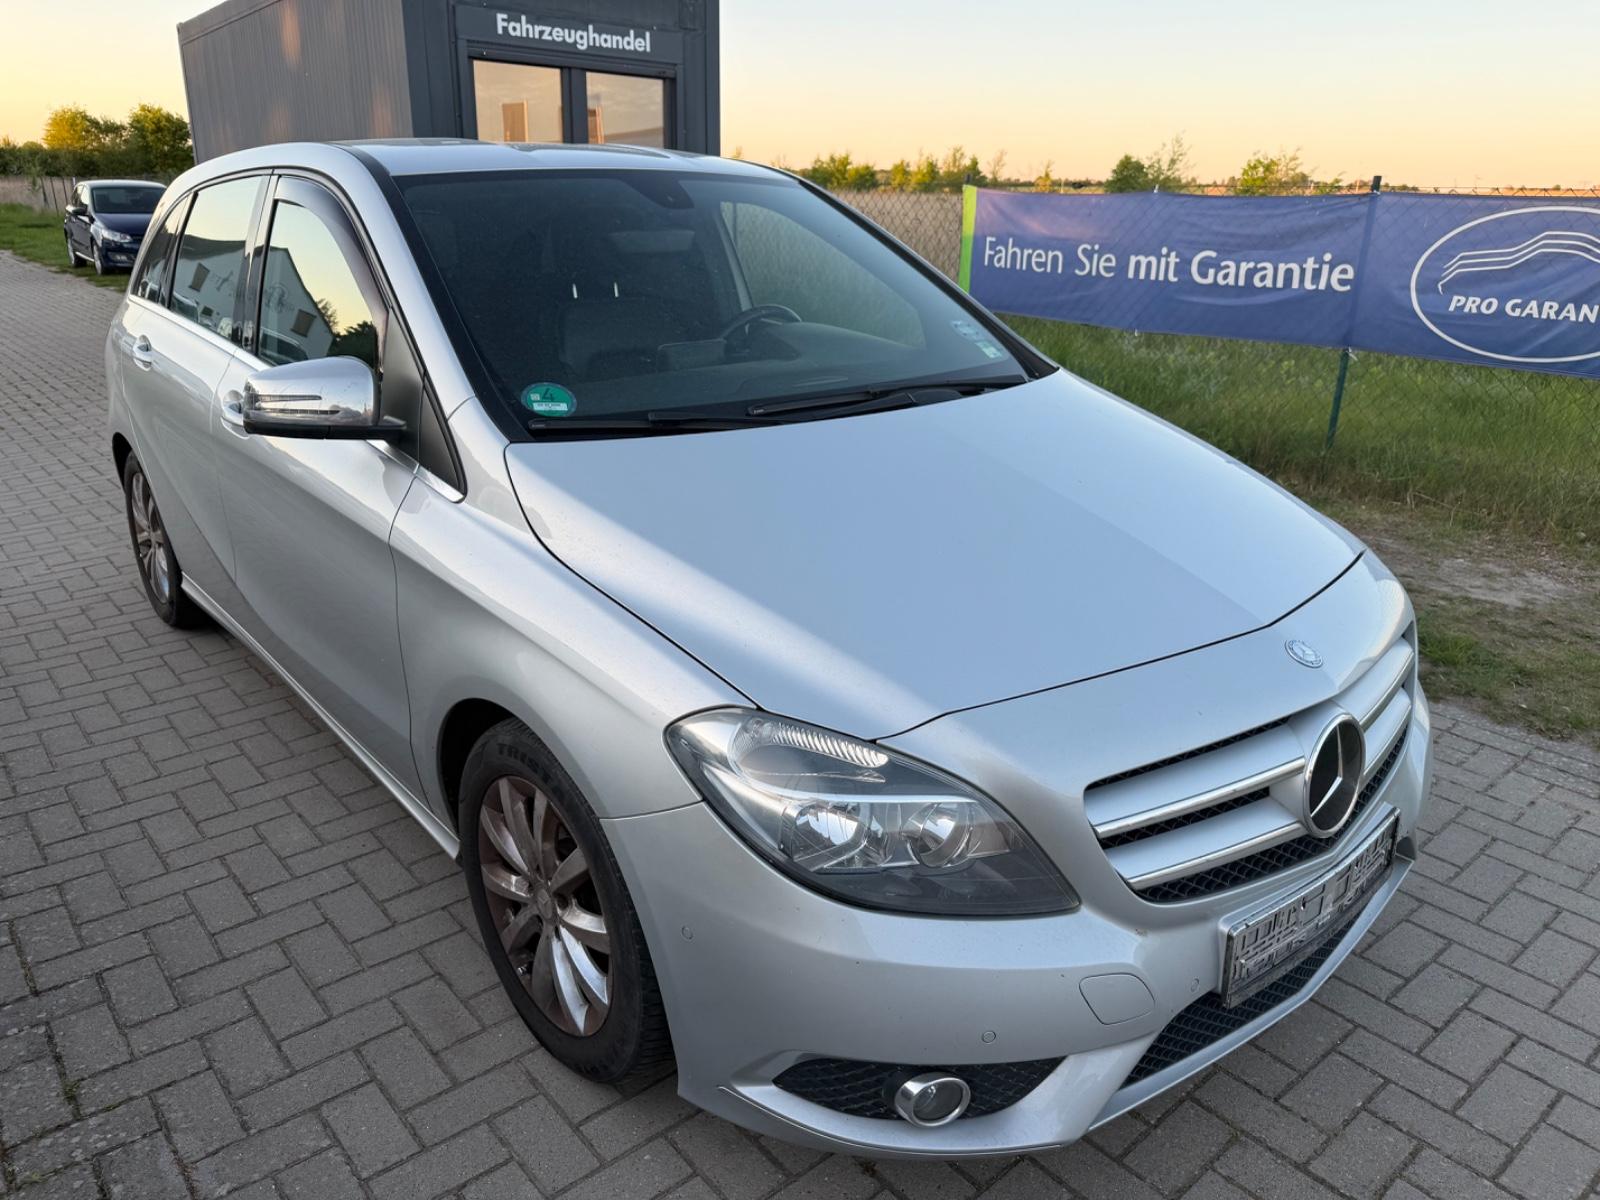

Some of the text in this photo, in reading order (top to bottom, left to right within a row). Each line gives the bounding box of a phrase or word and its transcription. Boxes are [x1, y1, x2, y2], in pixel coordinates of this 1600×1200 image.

[496, 12, 651, 53] Fahrzeughandel
[984, 236, 1355, 292] Fahren Sie mit Garantie
[1448, 295, 1600, 323] PRO GARAN
